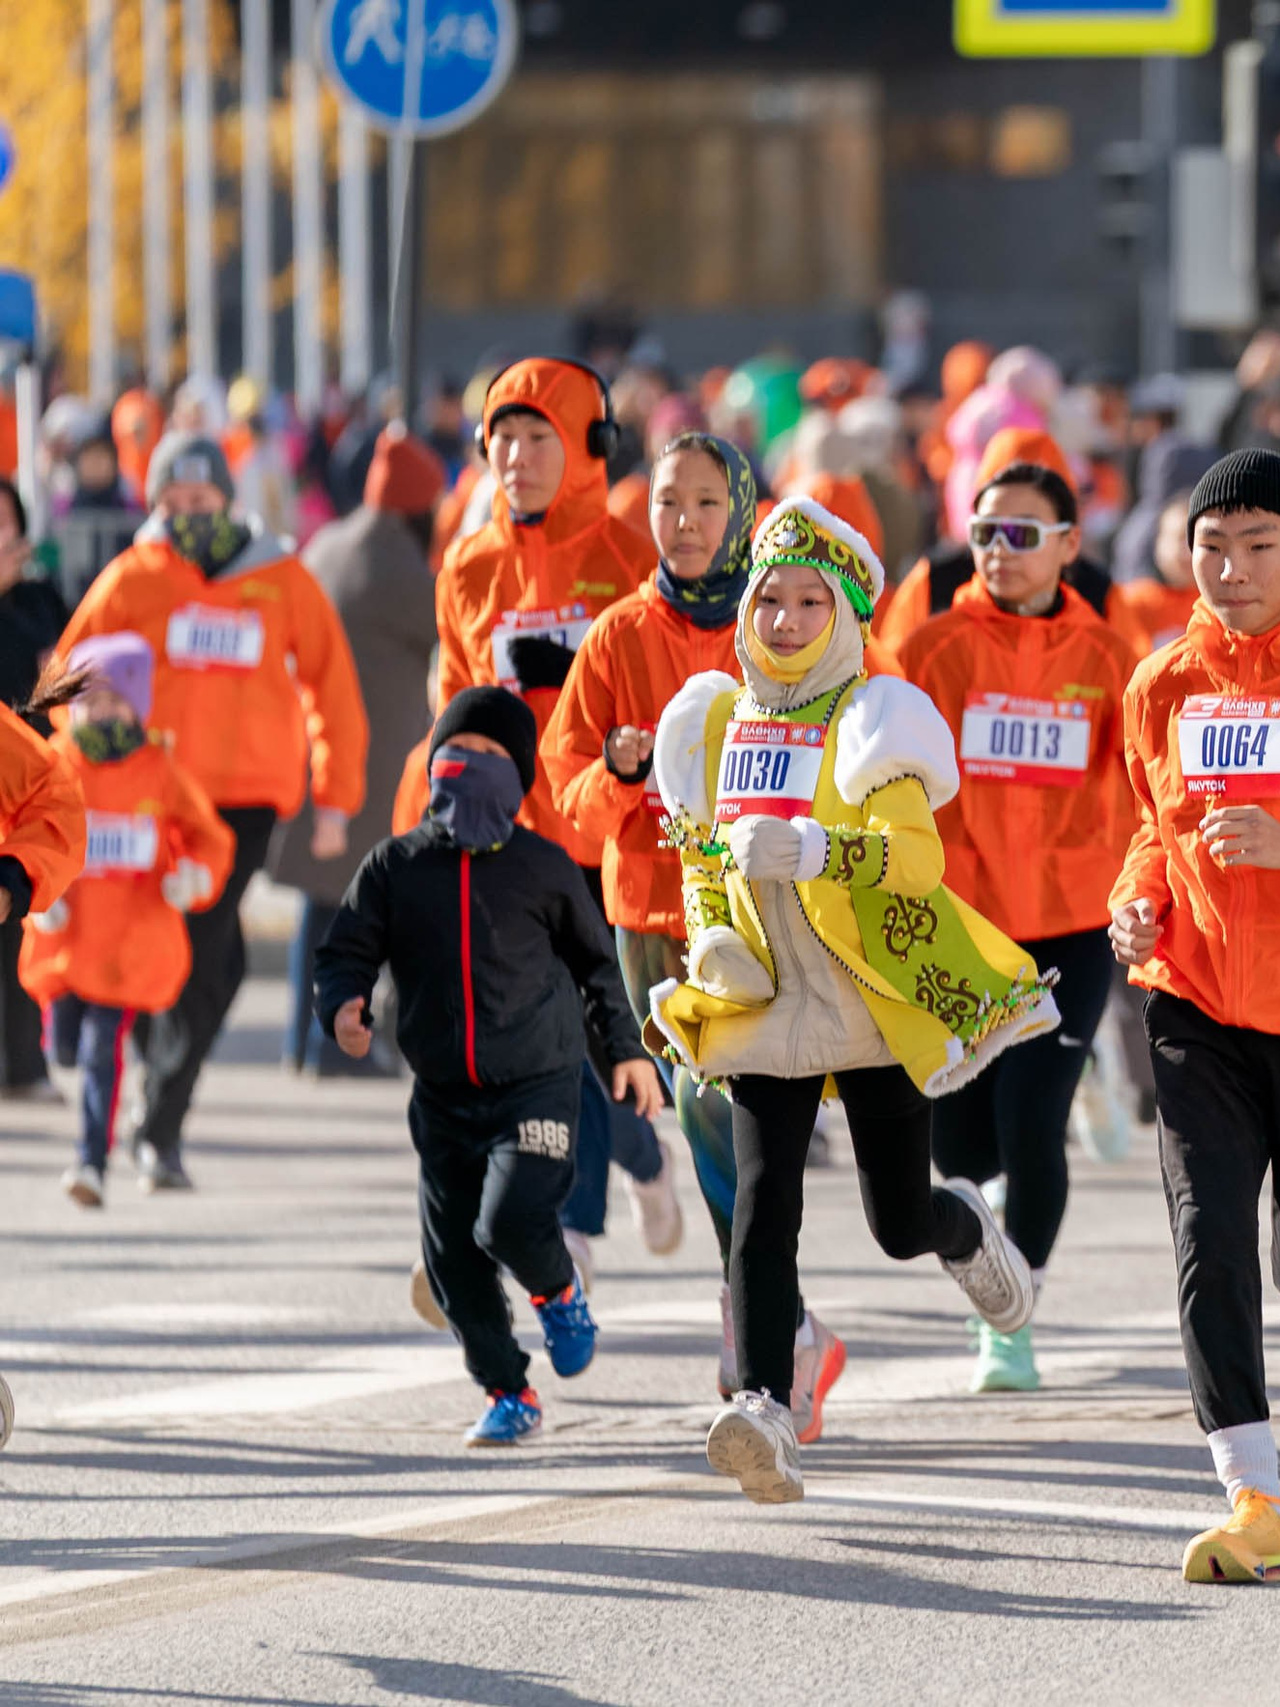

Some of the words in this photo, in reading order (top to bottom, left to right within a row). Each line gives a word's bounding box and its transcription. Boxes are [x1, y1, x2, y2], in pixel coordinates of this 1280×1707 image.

[990, 718, 1061, 760] 0013
[1202, 724, 1270, 768] 0064
[723, 749, 791, 792] 0030
[517, 1119, 570, 1152] 1986
